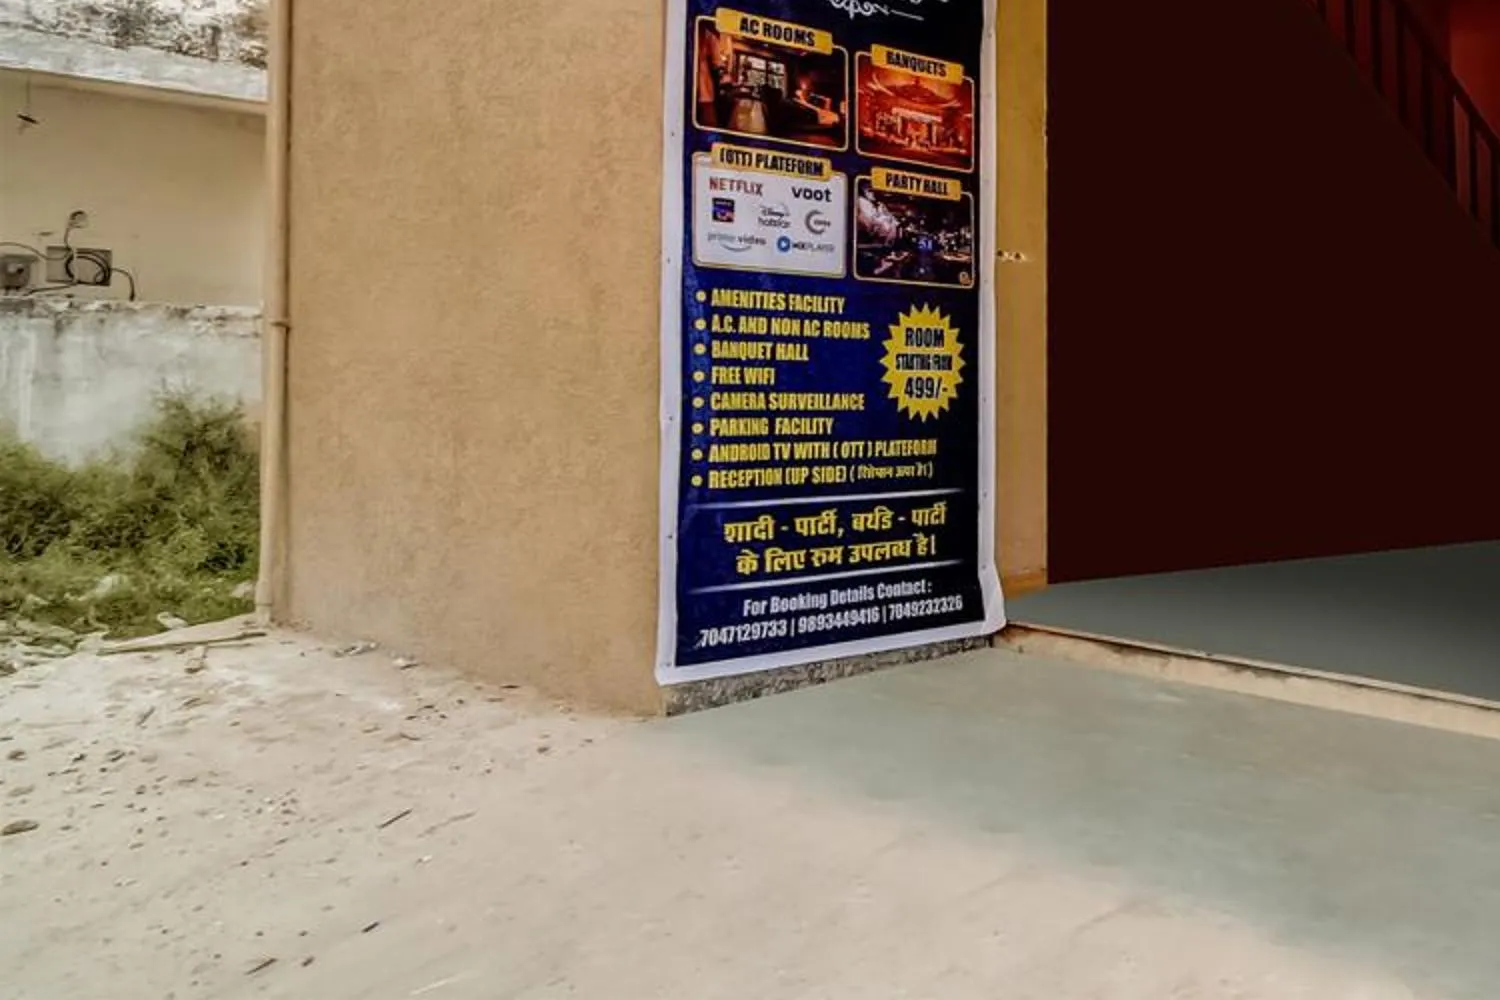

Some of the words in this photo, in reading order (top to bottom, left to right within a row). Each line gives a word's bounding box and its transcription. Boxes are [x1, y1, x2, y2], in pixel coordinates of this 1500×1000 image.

[739, 19, 760, 34] AC
[763, 22, 815, 47] ROOMS
[887, 51, 947, 77] BANQUETS
[755, 154, 824, 177] PLATEFORM
[709, 177, 764, 196] NETFLIX
[711, 288, 786, 311] AMENITIES
[789, 293, 845, 314] FACILITY
[739, 315, 767, 335] AND
[771, 317, 801, 336] NON
[803, 319, 821, 337] AC
[823, 320, 870, 340] ROOMS
[905, 327, 945, 348] ROOM
[711, 340, 773, 361] BANQUET
[775, 343, 809, 361] HALL
[711, 366, 741, 385] FREE
[743, 366, 775, 385] WIFI
[904, 376, 948, 399] 499/-
[711, 391, 766, 411] CAMERA
[769, 393, 865, 411] SURVEILLANCE
[710, 417, 769, 436] PARKING
[775, 417, 834, 436] FACILITY
[708, 443, 771, 463] ANDROID
[773, 442, 792, 460] TV
[794, 441, 831, 460] WITH
[875, 438, 937, 457] PLATEFORM
[708, 466, 782, 489] RECEPTION
[723, 513, 776, 543] शादी
[911, 501, 948, 527] पार्टी
[735, 550, 760, 576] के
[764, 547, 808, 574] लिए
[743, 599, 768, 617] For
[769, 593, 828, 611] Booking
[829, 584, 875, 607] Details
[700, 618, 787, 648] 7047129733
